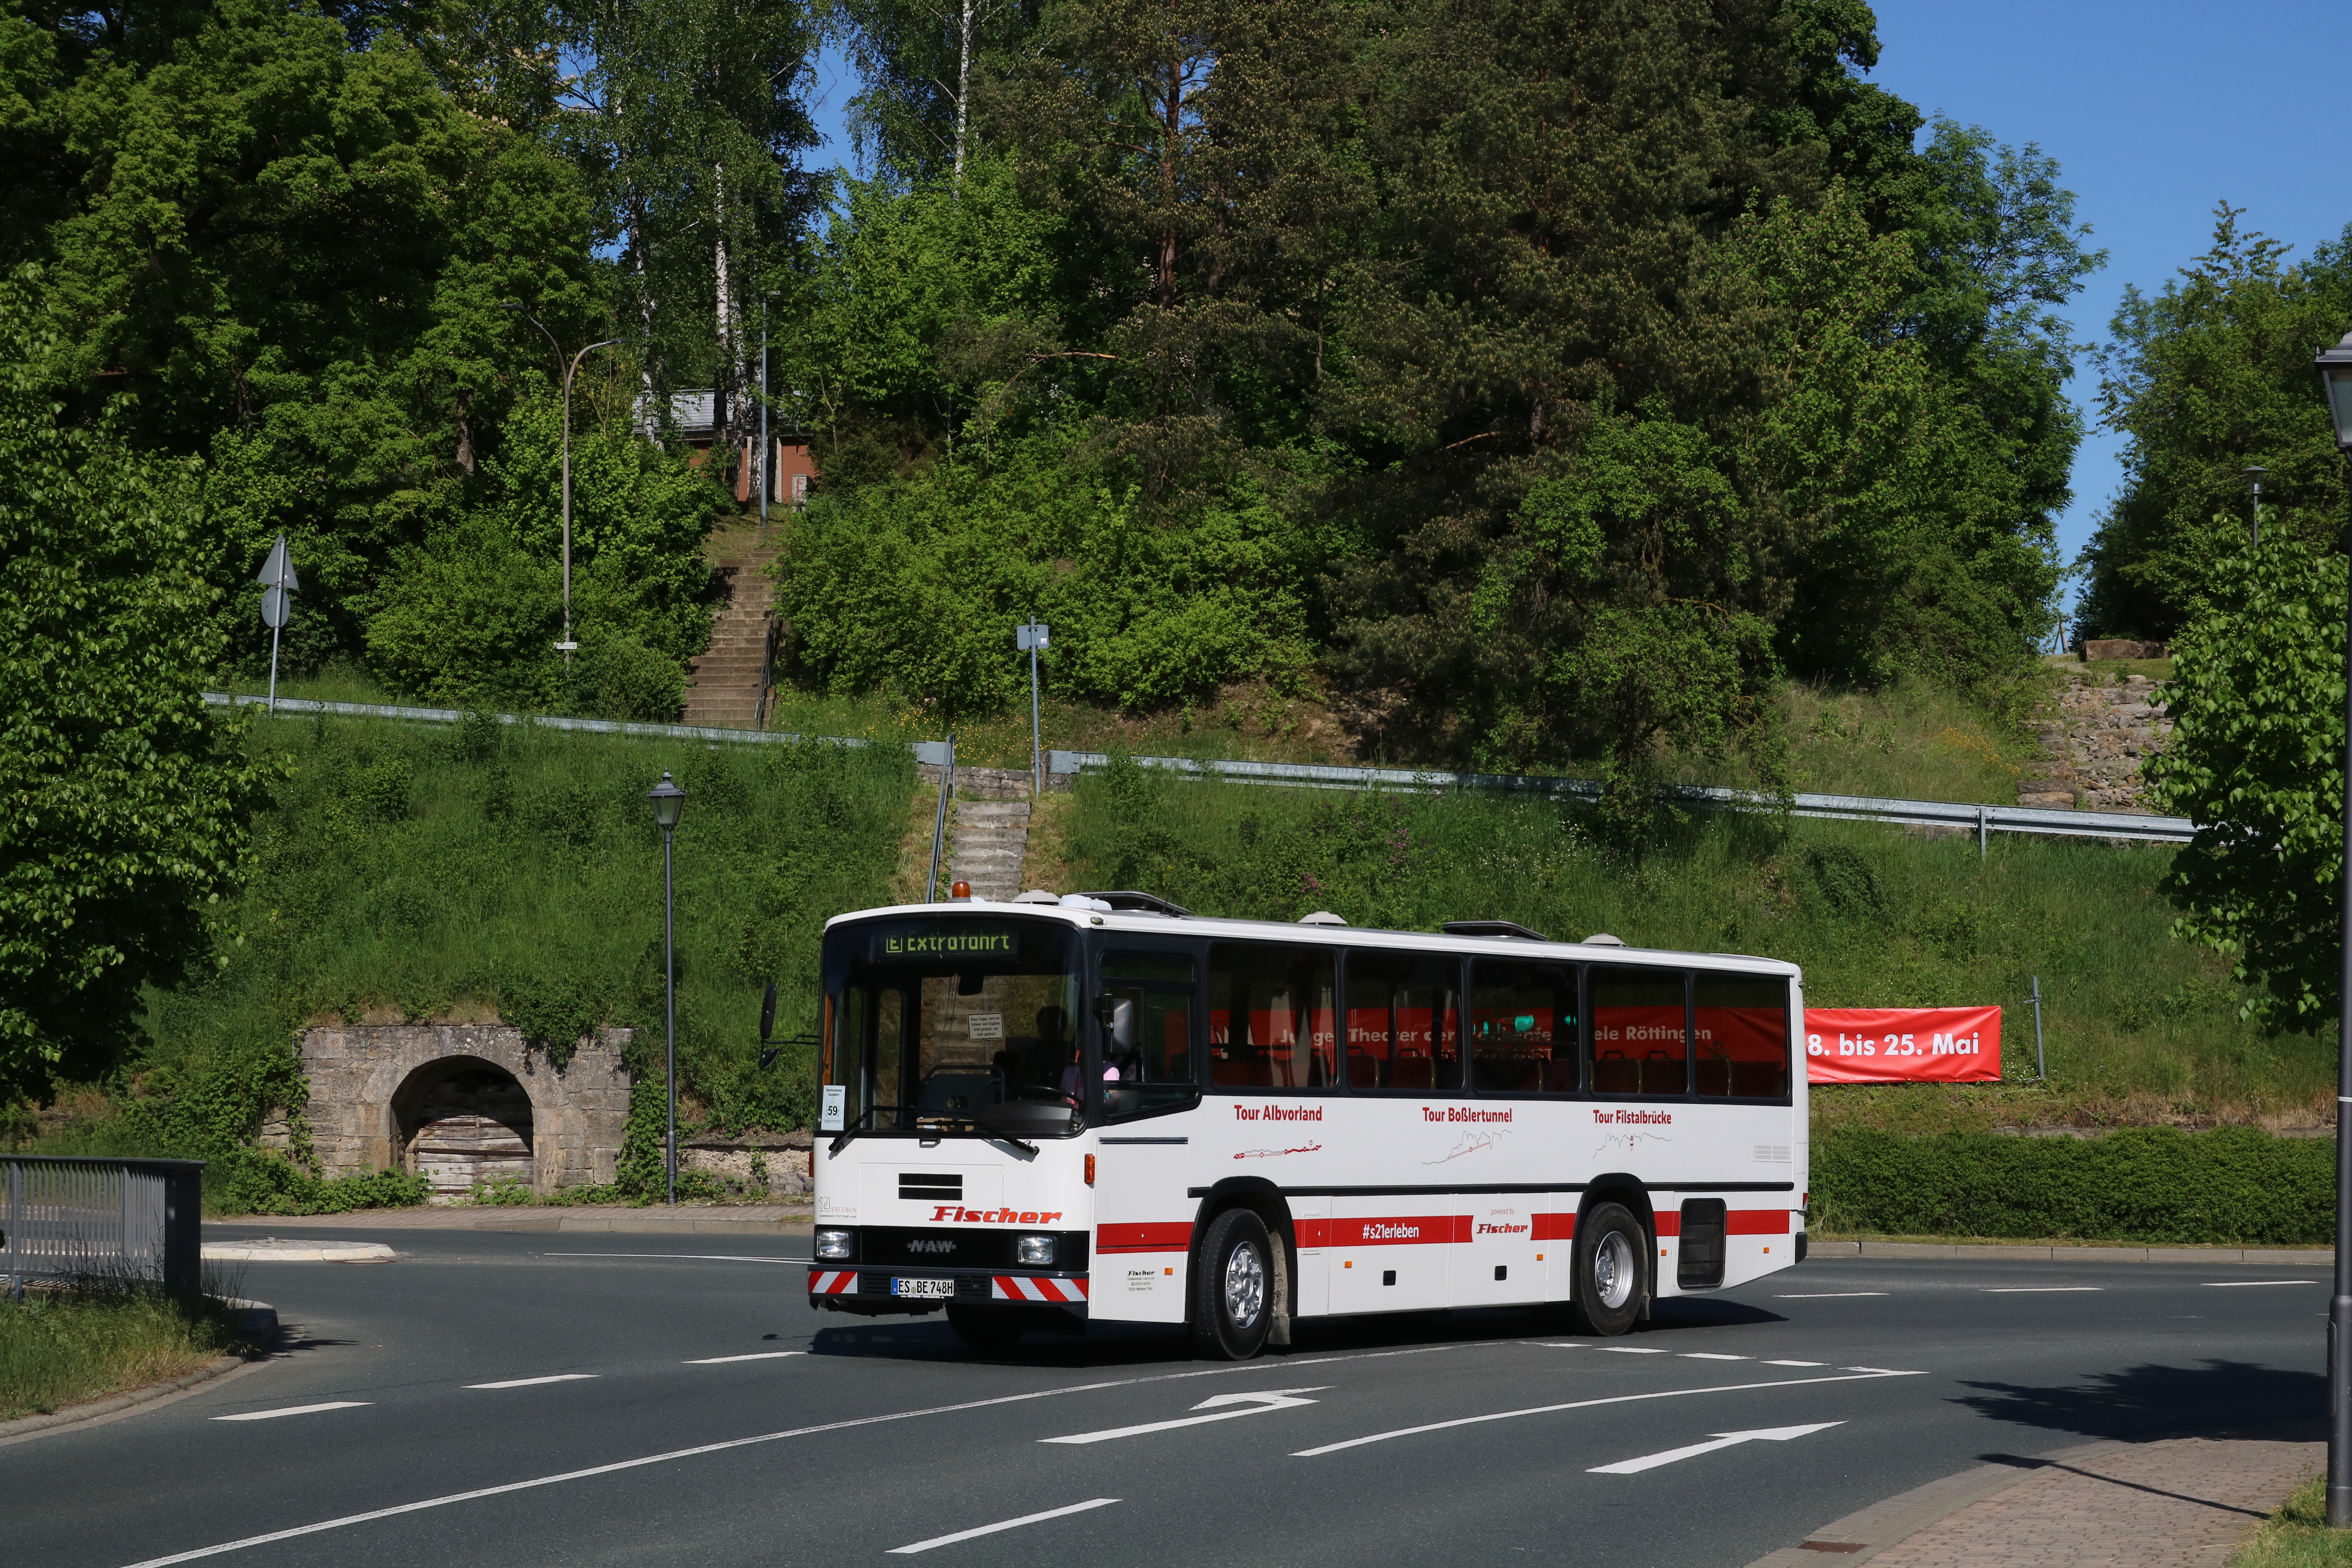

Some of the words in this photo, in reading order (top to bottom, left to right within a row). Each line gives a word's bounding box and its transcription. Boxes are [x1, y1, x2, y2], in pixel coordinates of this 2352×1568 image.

[908, 931, 1009, 951] Extrafahrt
[1839, 1033, 1876, 1056] bis
[1884, 1034, 1923, 1055] 25.
[1931, 1031, 1979, 1054] Mai
[828, 1106, 838, 1116] 59
[1234, 1105, 1260, 1120] Tour
[1262, 1104, 1322, 1121] Albvorland
[1422, 1107, 1445, 1122] Tour
[1448, 1107, 1512, 1123] Boßlertunnel
[1593, 1109, 1614, 1123] Tour
[1616, 1109, 1671, 1124] Filstalbrücke
[929, 1206, 1062, 1224] Fischer
[1491, 1208, 1508, 1216] powered
[1510, 1208, 1515, 1216] by
[1362, 1223, 1419, 1240] #s21erleben
[1476, 1223, 1528, 1234] Fischer
[910, 1240, 953, 1253] NAW
[898, 1280, 910, 1293] ES
[917, 1281, 928, 1293] BE
[931, 1281, 953, 1294] 748H
